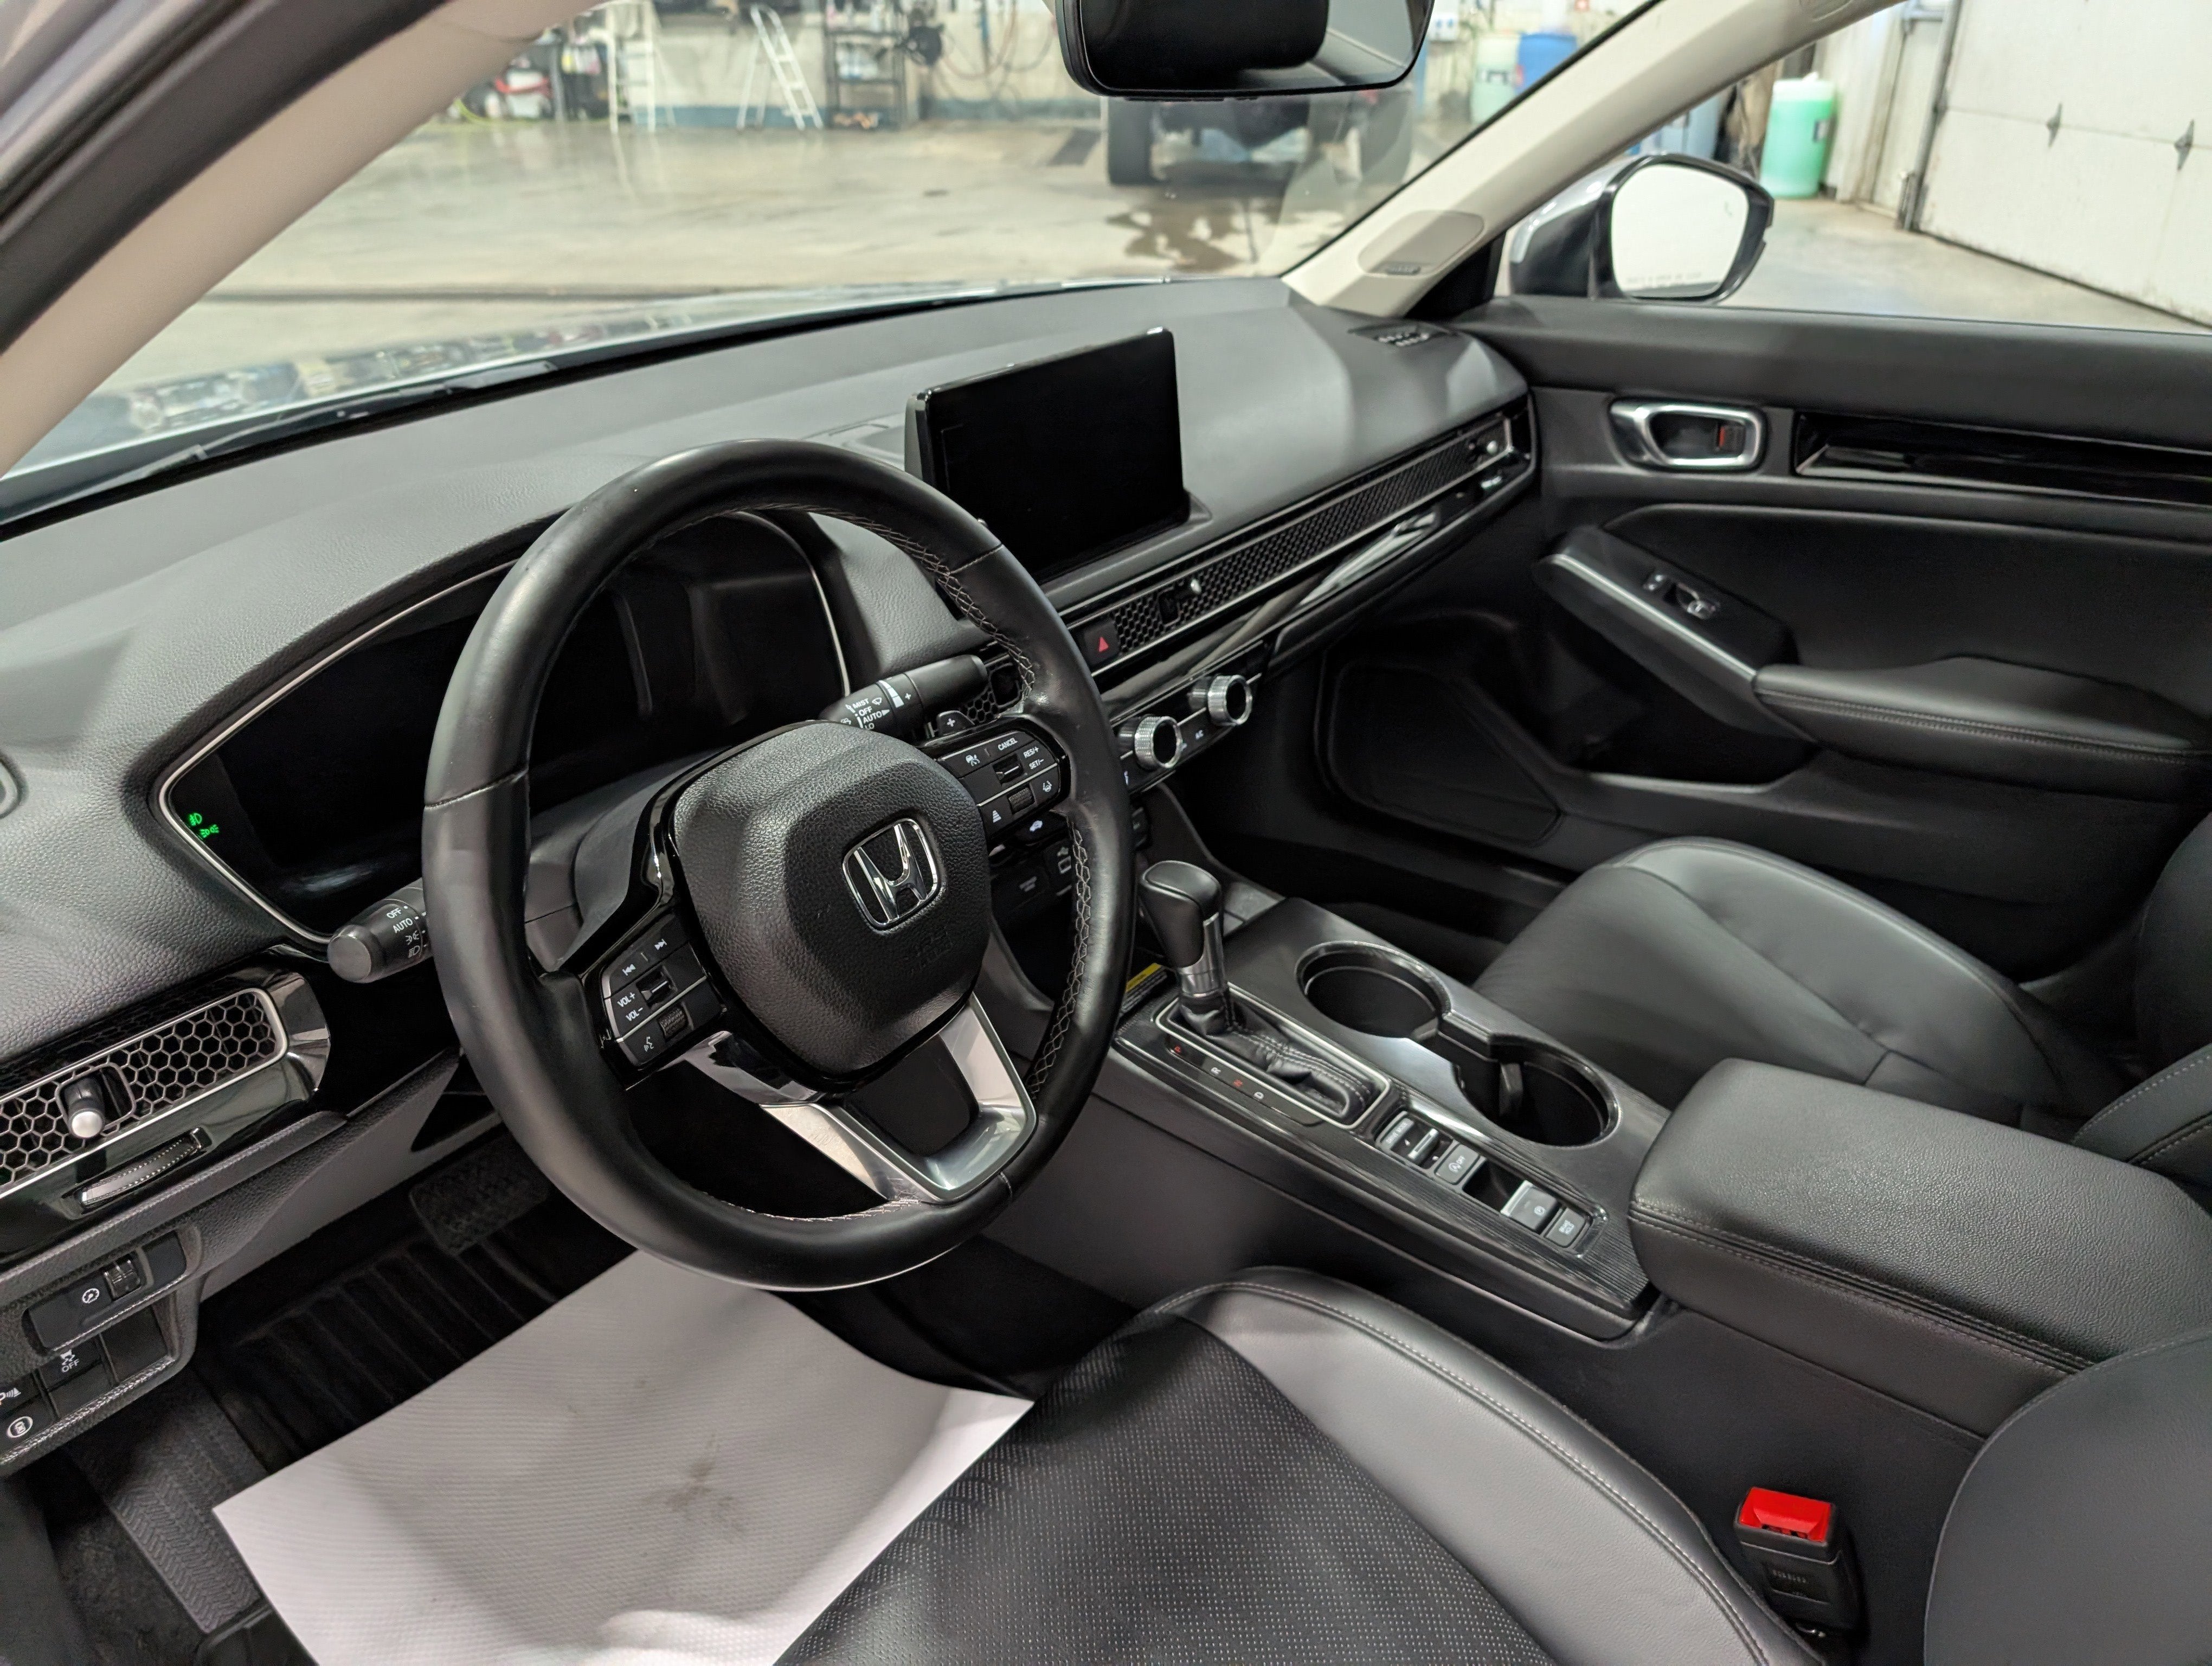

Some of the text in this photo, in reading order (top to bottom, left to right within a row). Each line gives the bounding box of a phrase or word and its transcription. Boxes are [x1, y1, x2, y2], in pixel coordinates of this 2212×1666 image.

[852, 698, 869, 709] MIST
[858, 706, 872, 716] OFF
[863, 710, 882, 724] AUTO
[998, 737, 1018, 751] CANCEL
[386, 907, 402, 919] OFF
[392, 918, 413, 933] AUTO
[1210, 1067, 1221, 1075] R
[61, 1358, 80, 1373] OFF
